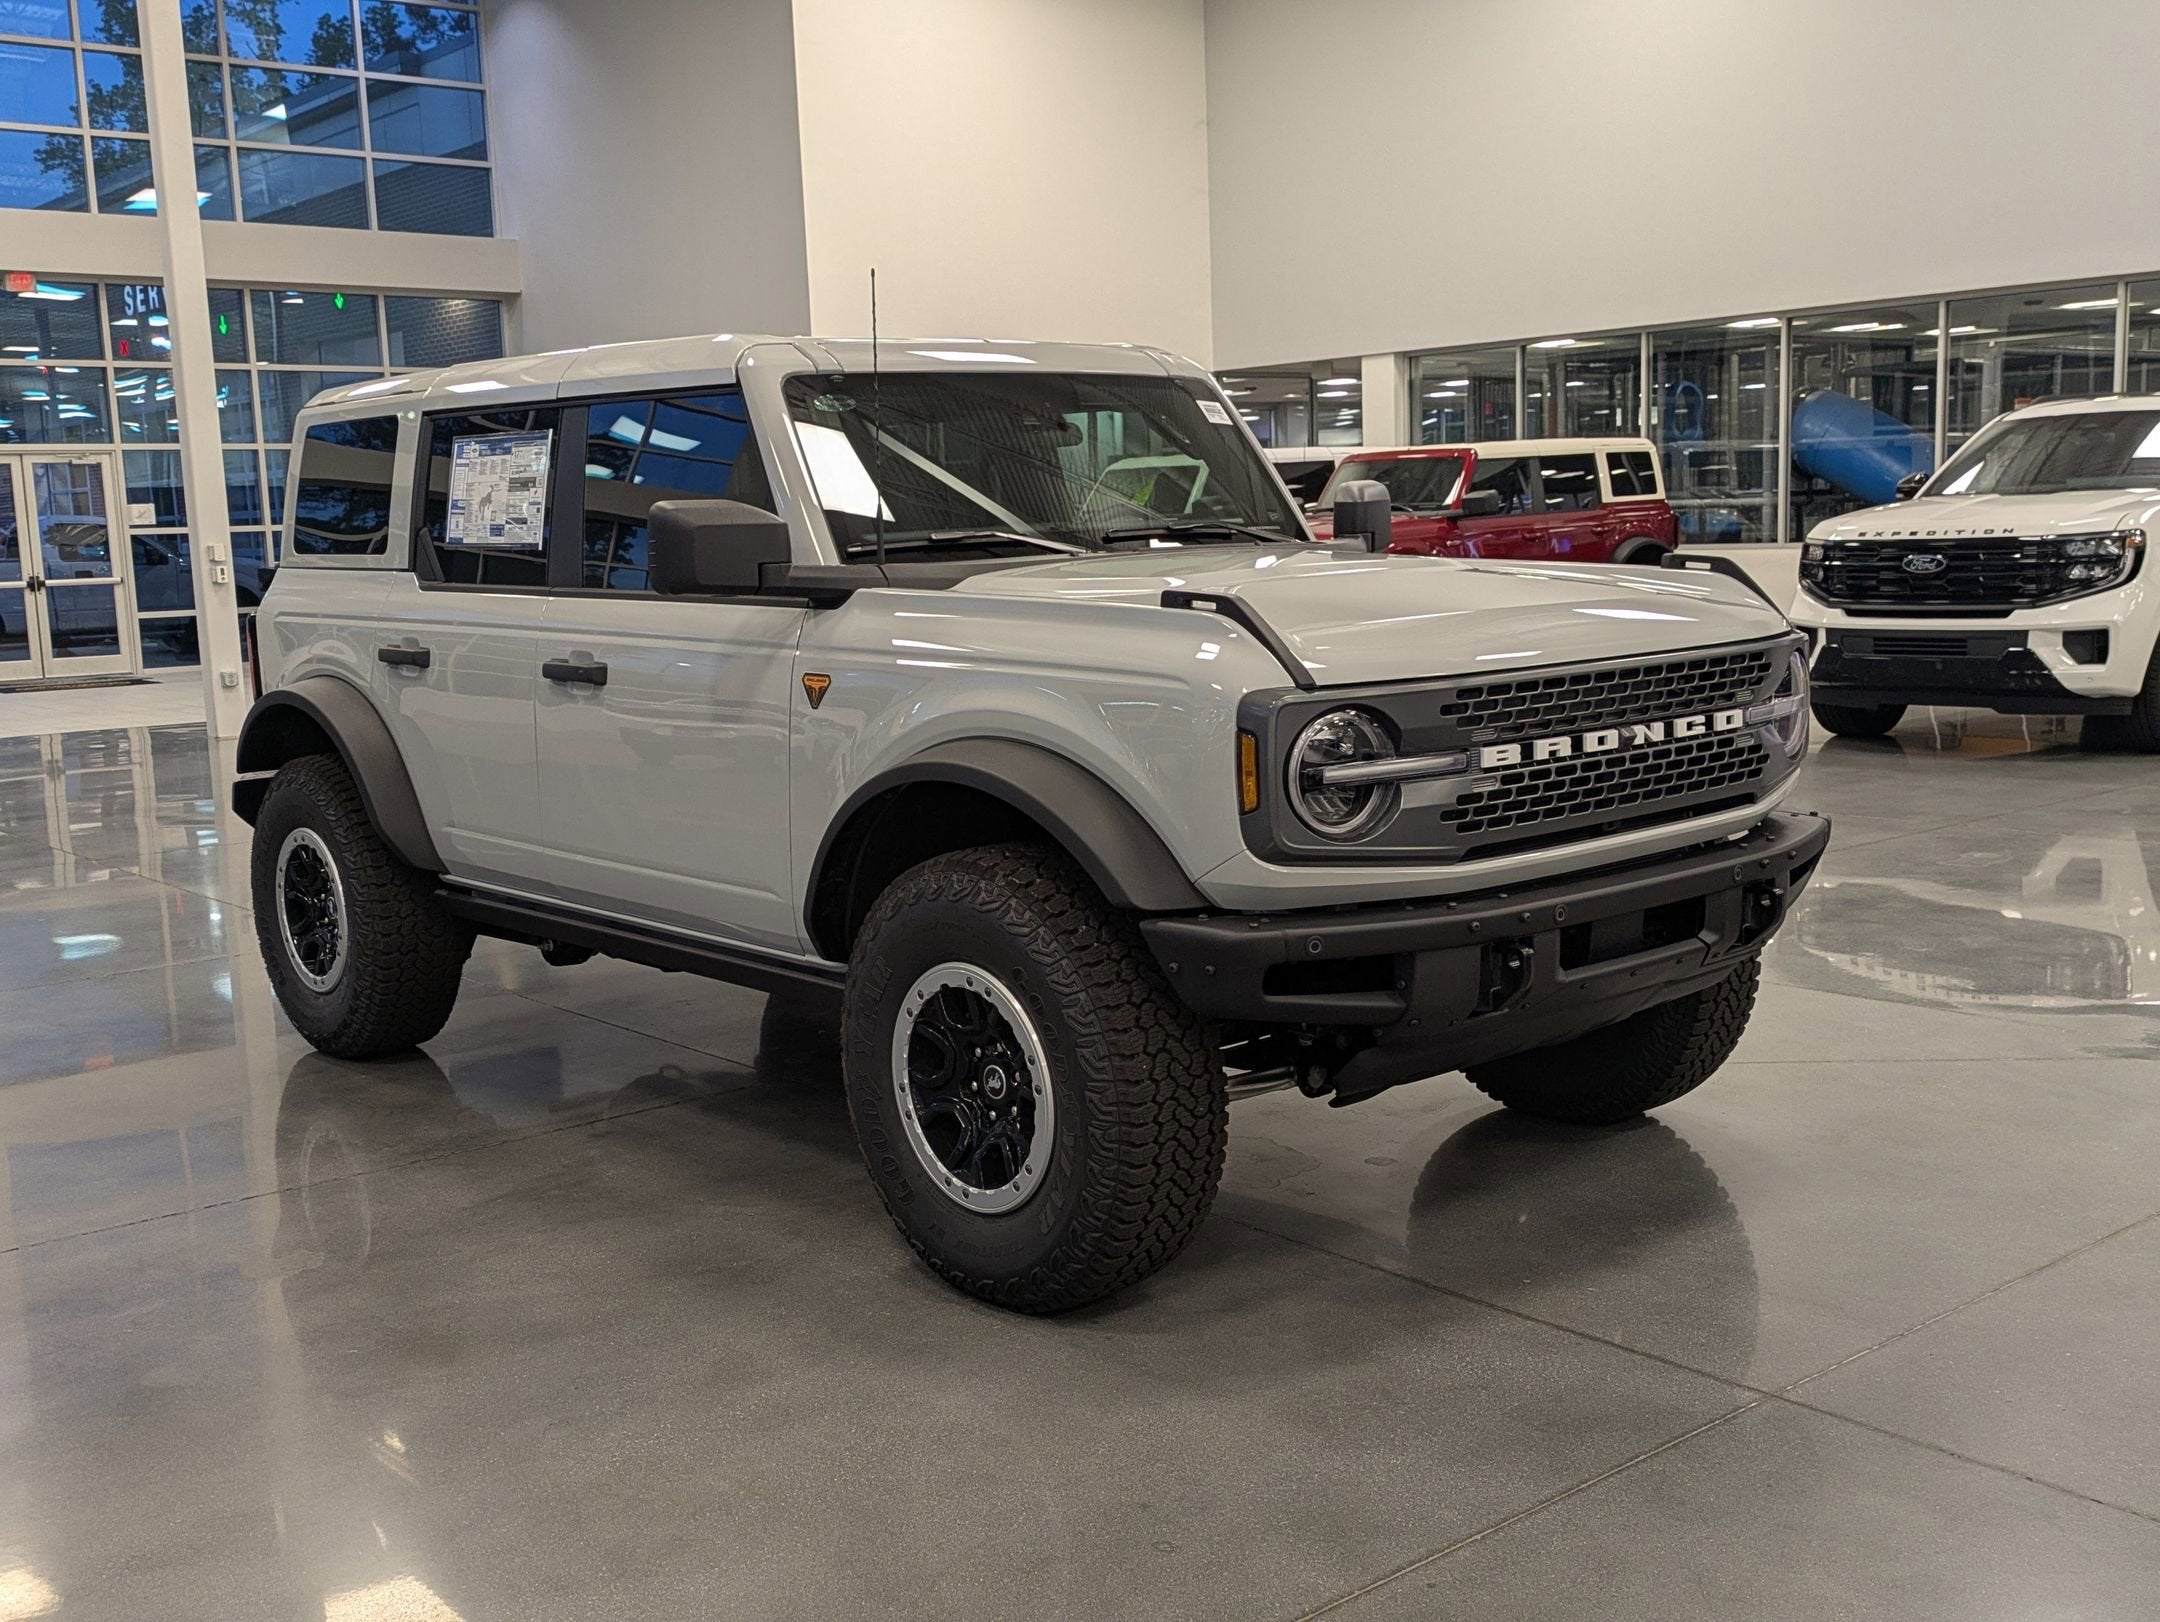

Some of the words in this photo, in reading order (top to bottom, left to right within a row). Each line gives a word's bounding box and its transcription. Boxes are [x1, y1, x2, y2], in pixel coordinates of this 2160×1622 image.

[1857, 528, 2015, 537] EXPEDITION
[1909, 557, 1937, 571] Ford
[1480, 708, 1743, 768] BRONCO
